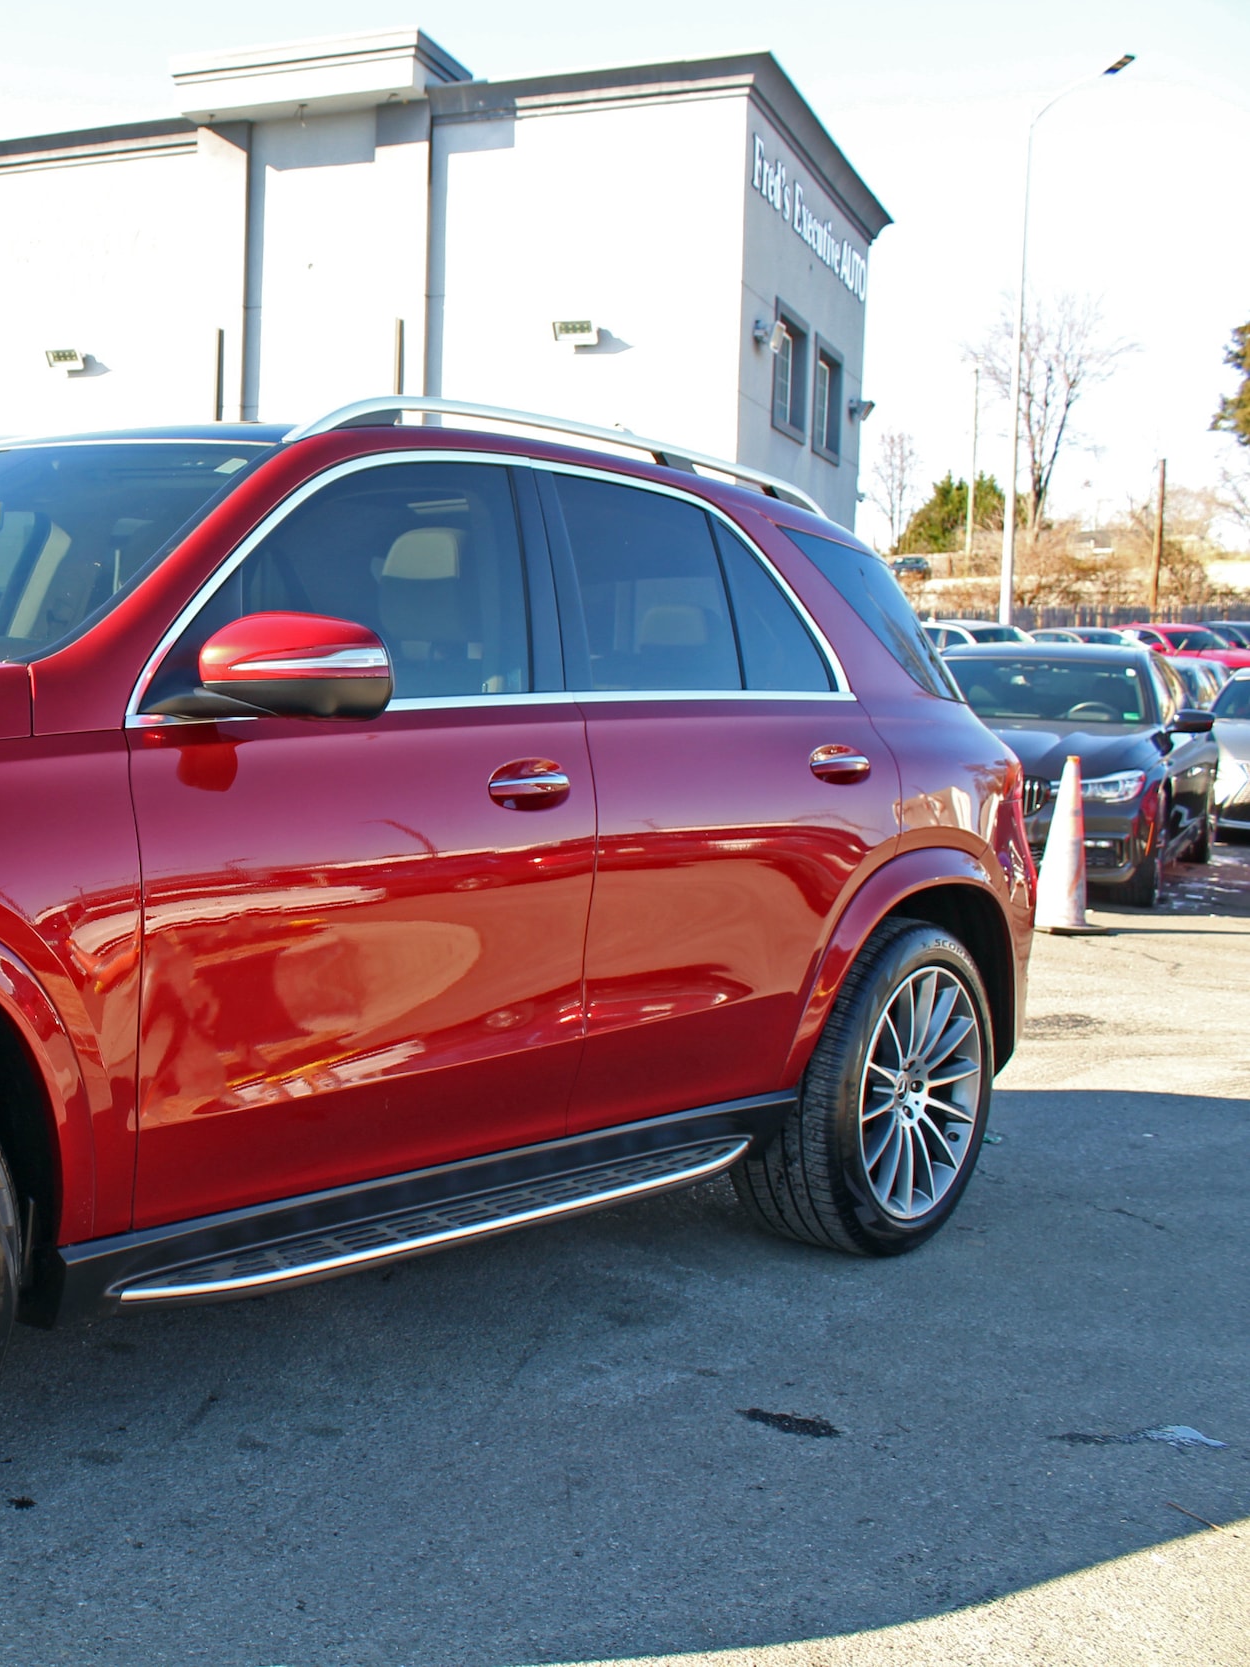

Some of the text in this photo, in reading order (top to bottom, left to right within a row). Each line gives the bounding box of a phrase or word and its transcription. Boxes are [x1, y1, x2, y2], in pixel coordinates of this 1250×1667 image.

[753, 133, 867, 302] Fred's Executive AUTO
